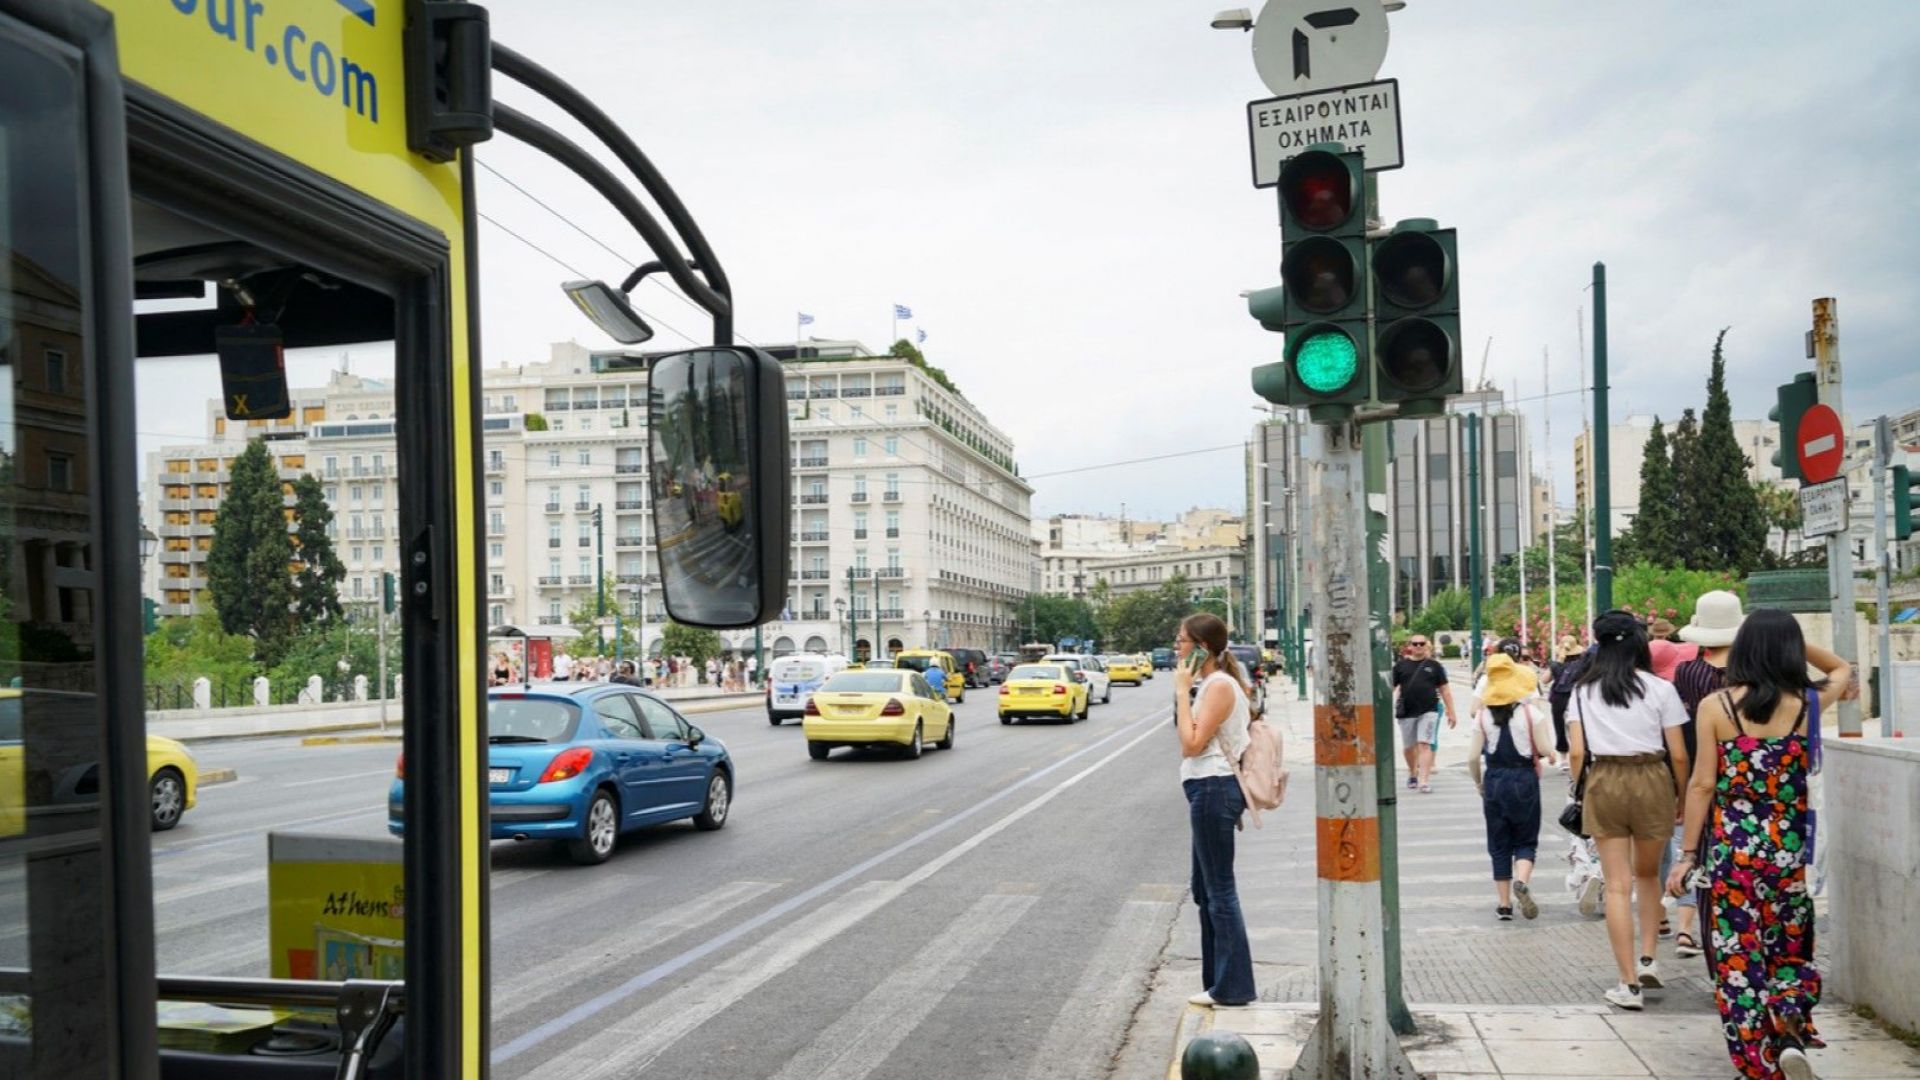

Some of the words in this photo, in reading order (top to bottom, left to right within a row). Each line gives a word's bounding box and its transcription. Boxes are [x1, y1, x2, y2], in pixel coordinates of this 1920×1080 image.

[1258, 92, 1389, 128] ΕΞΑΙΡΟΥΝΤΑΙ
[1278, 120, 1372, 149] ΟΧΗΜΑΤΑ
[323, 891, 388, 917] Athens
